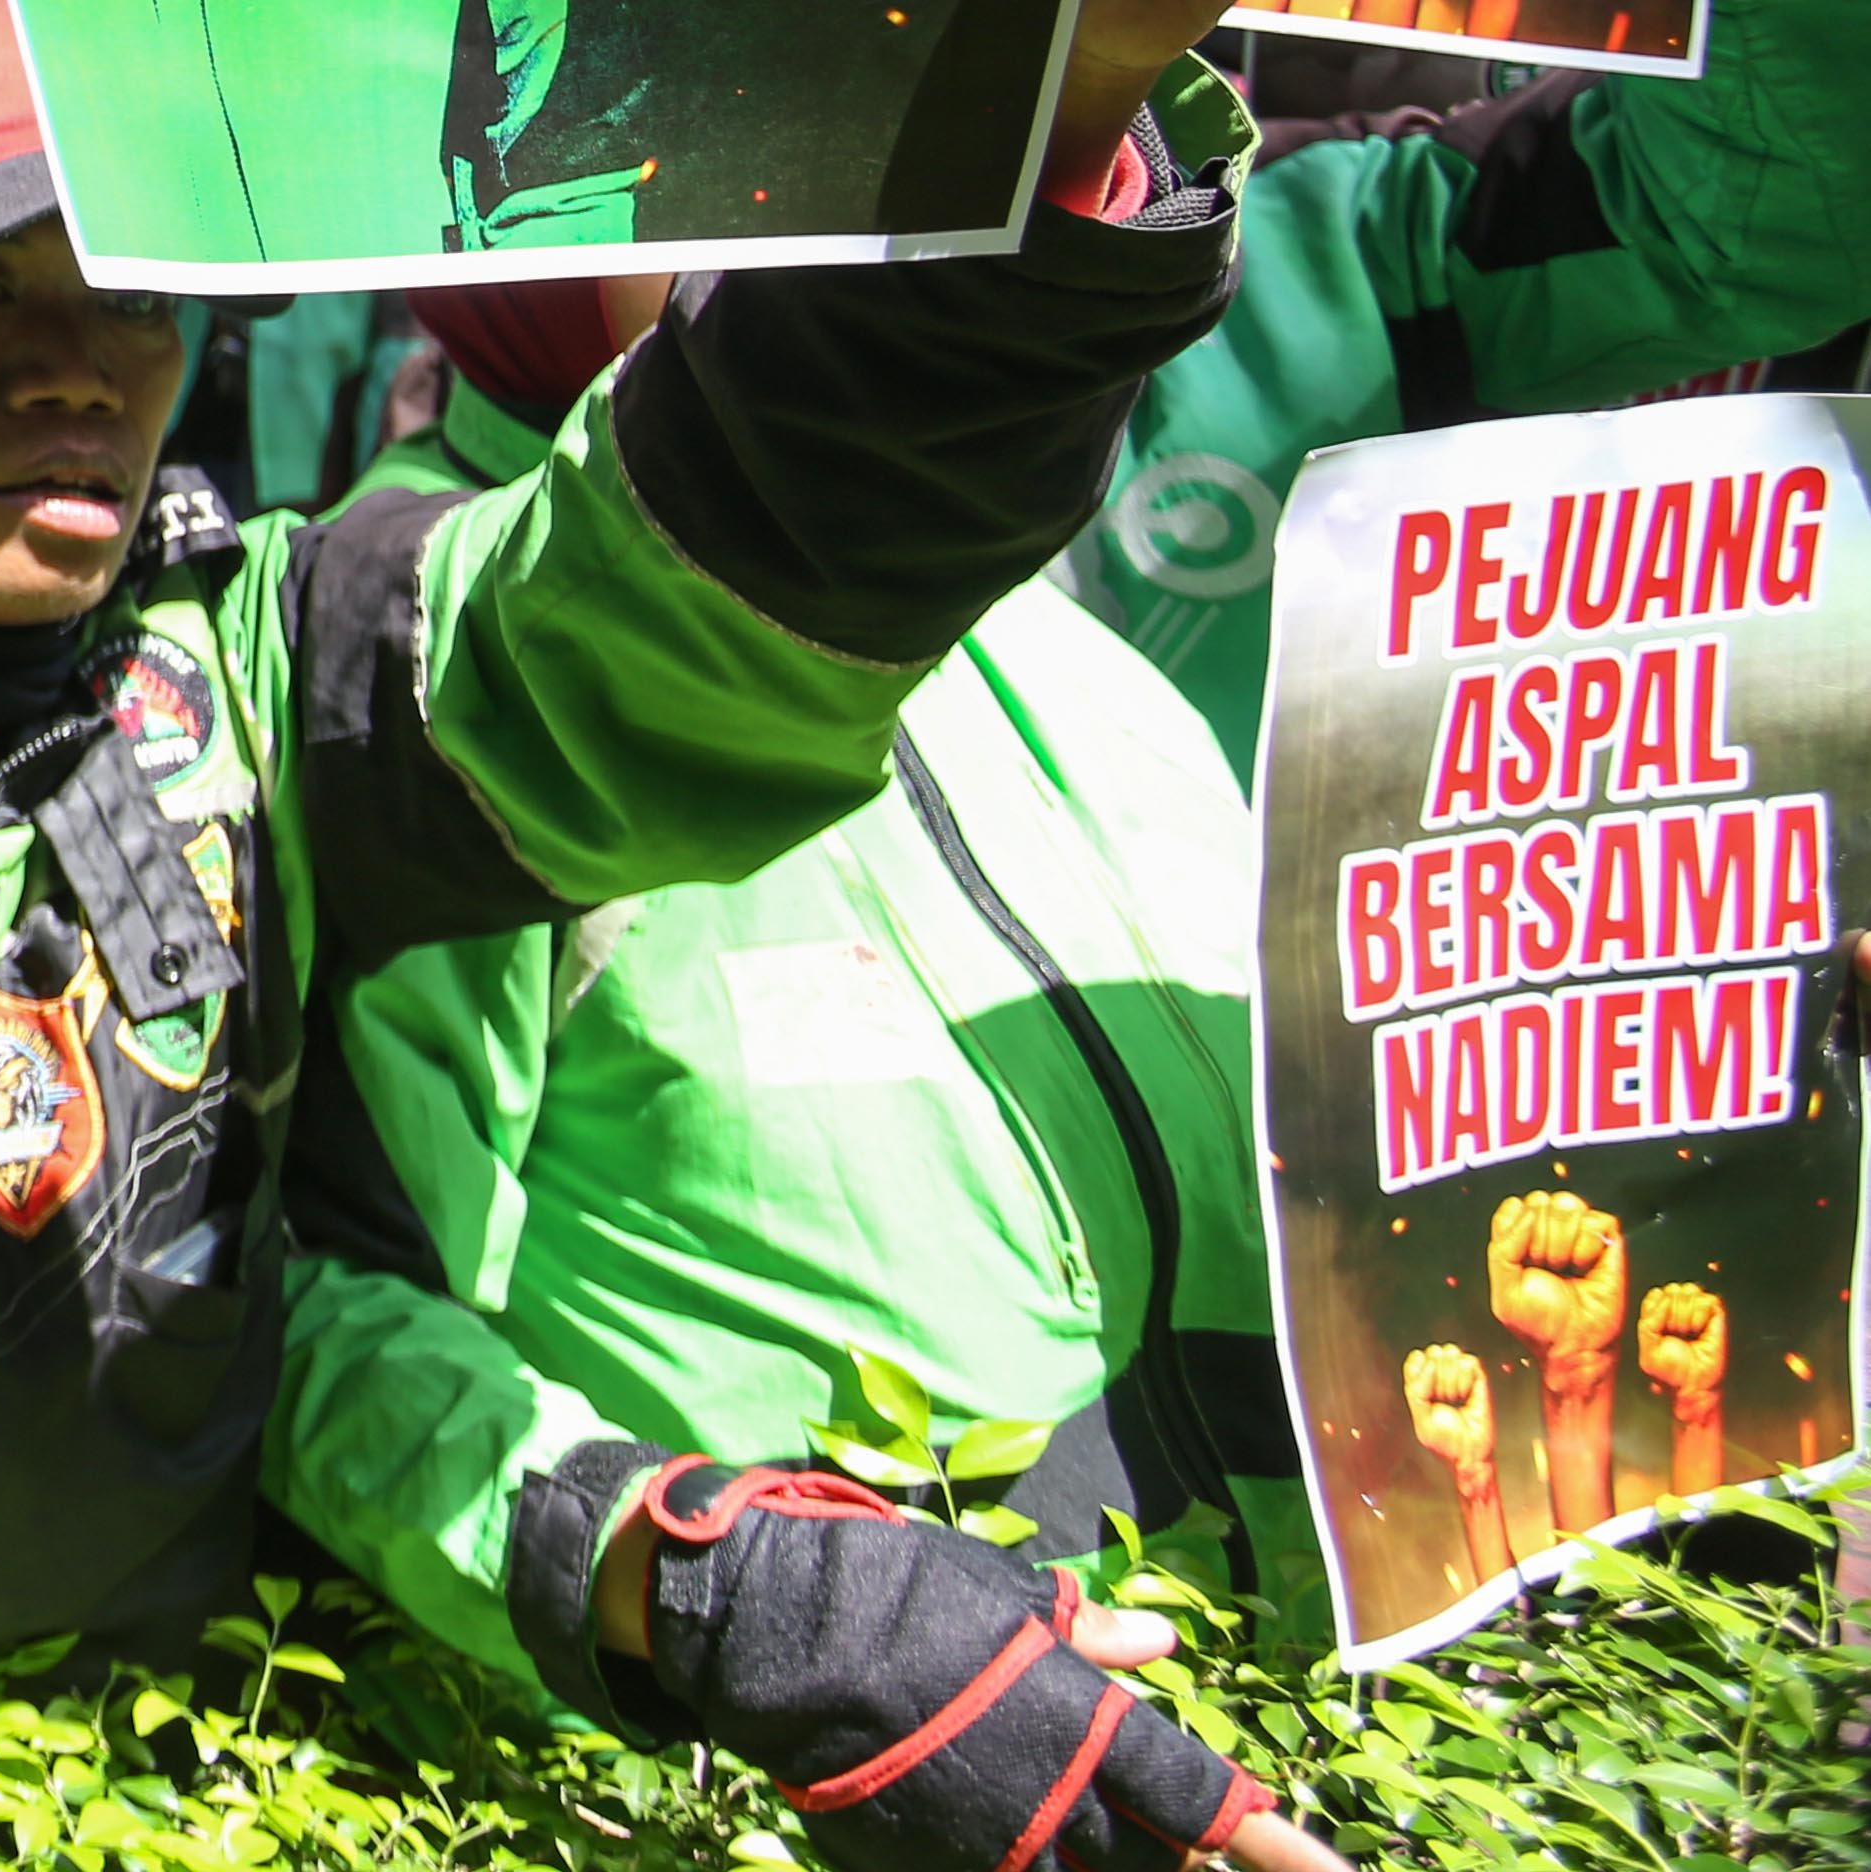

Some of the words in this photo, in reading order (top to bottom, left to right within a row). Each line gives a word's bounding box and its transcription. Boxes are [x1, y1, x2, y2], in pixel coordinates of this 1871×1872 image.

[1384, 464, 1828, 661] PEJUANG
[1421, 635, 1748, 829] ASPAL
[1339, 793, 1832, 1023] BERSAMA
[1373, 969, 1801, 1195] NADIEM!
